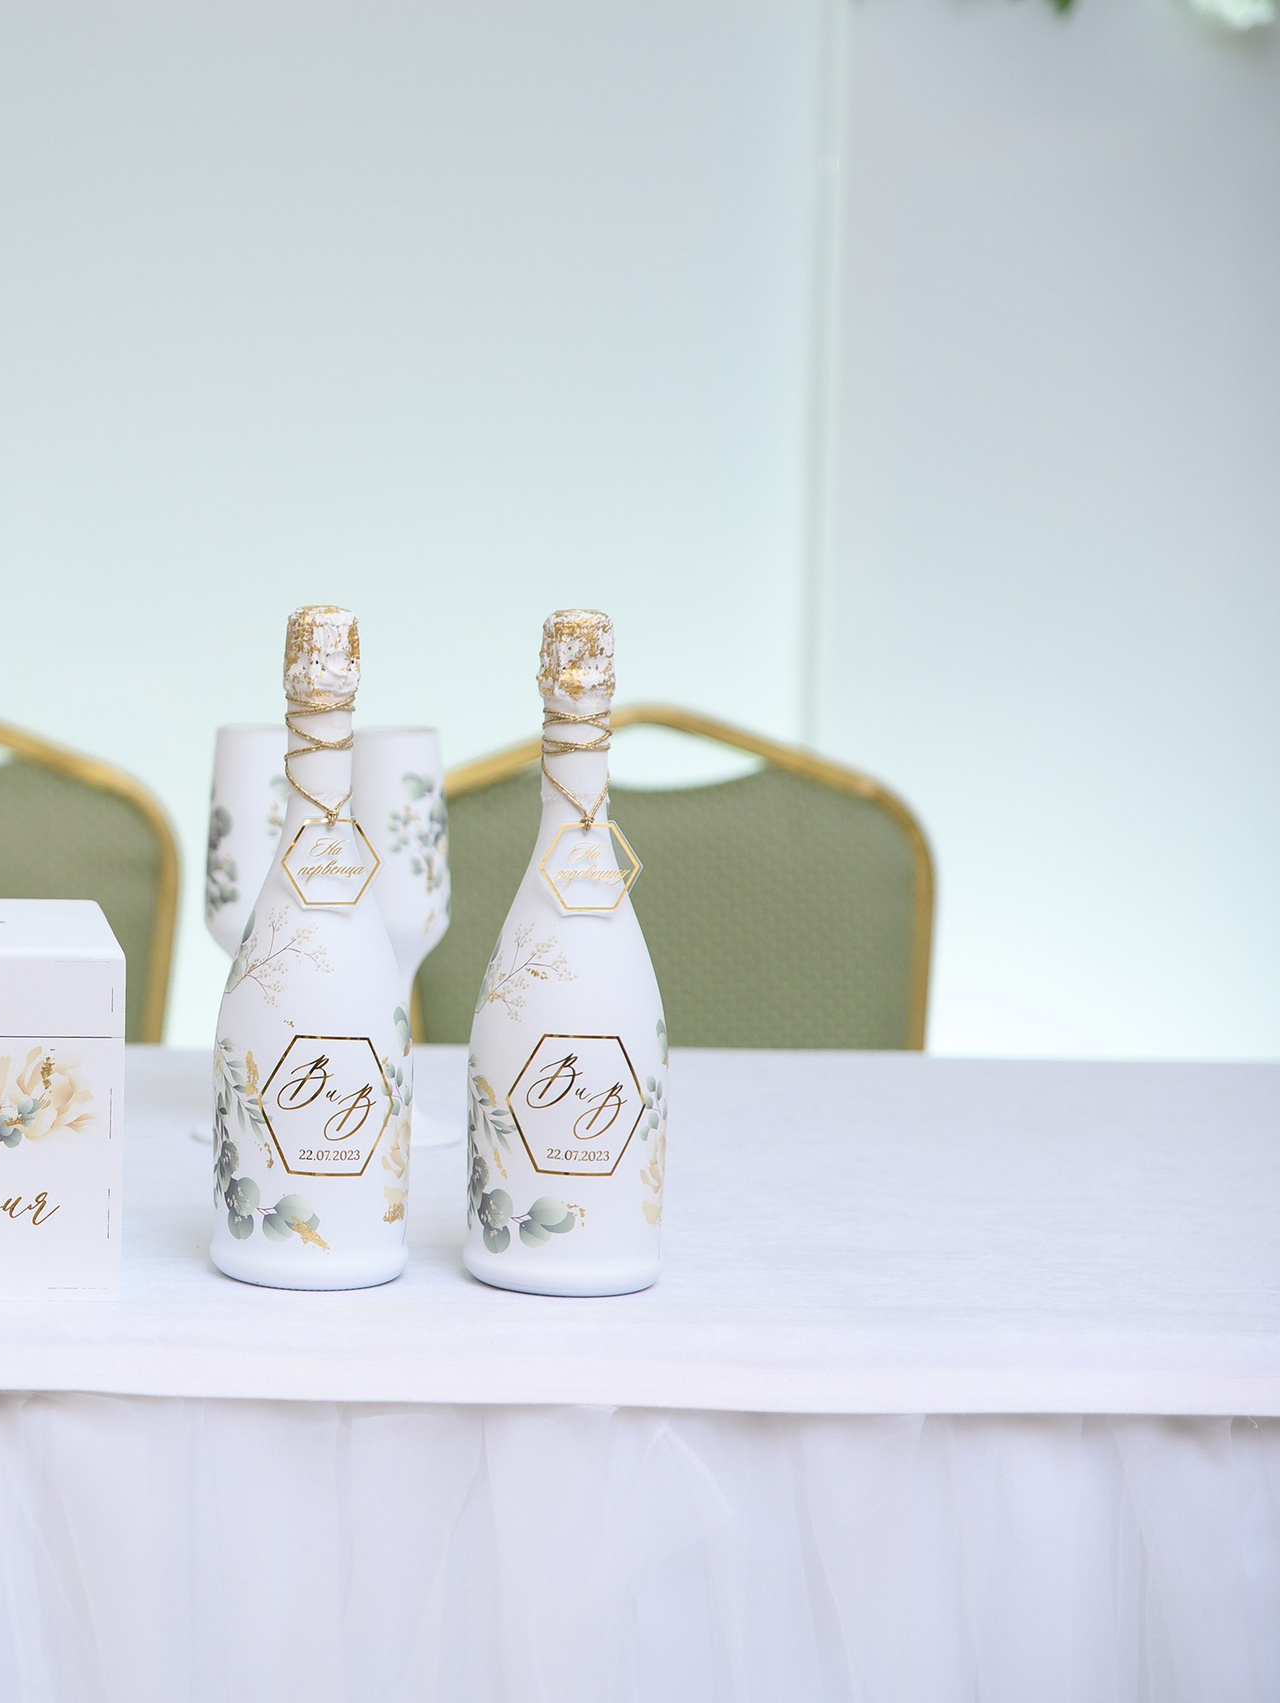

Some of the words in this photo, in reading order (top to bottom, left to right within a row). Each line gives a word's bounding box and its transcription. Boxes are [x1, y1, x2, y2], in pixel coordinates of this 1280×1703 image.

[309, 837, 350, 857] На
[567, 841, 608, 864] На
[296, 859, 365, 884] первенца
[277, 1054, 335, 1110] В
[323, 1083, 377, 1141] В
[526, 1052, 583, 1109] В
[573, 1081, 628, 1140] В
[298, 1149, 361, 1161] 22.07.2023
[546, 1147, 610, 1162] 22.07.2023
